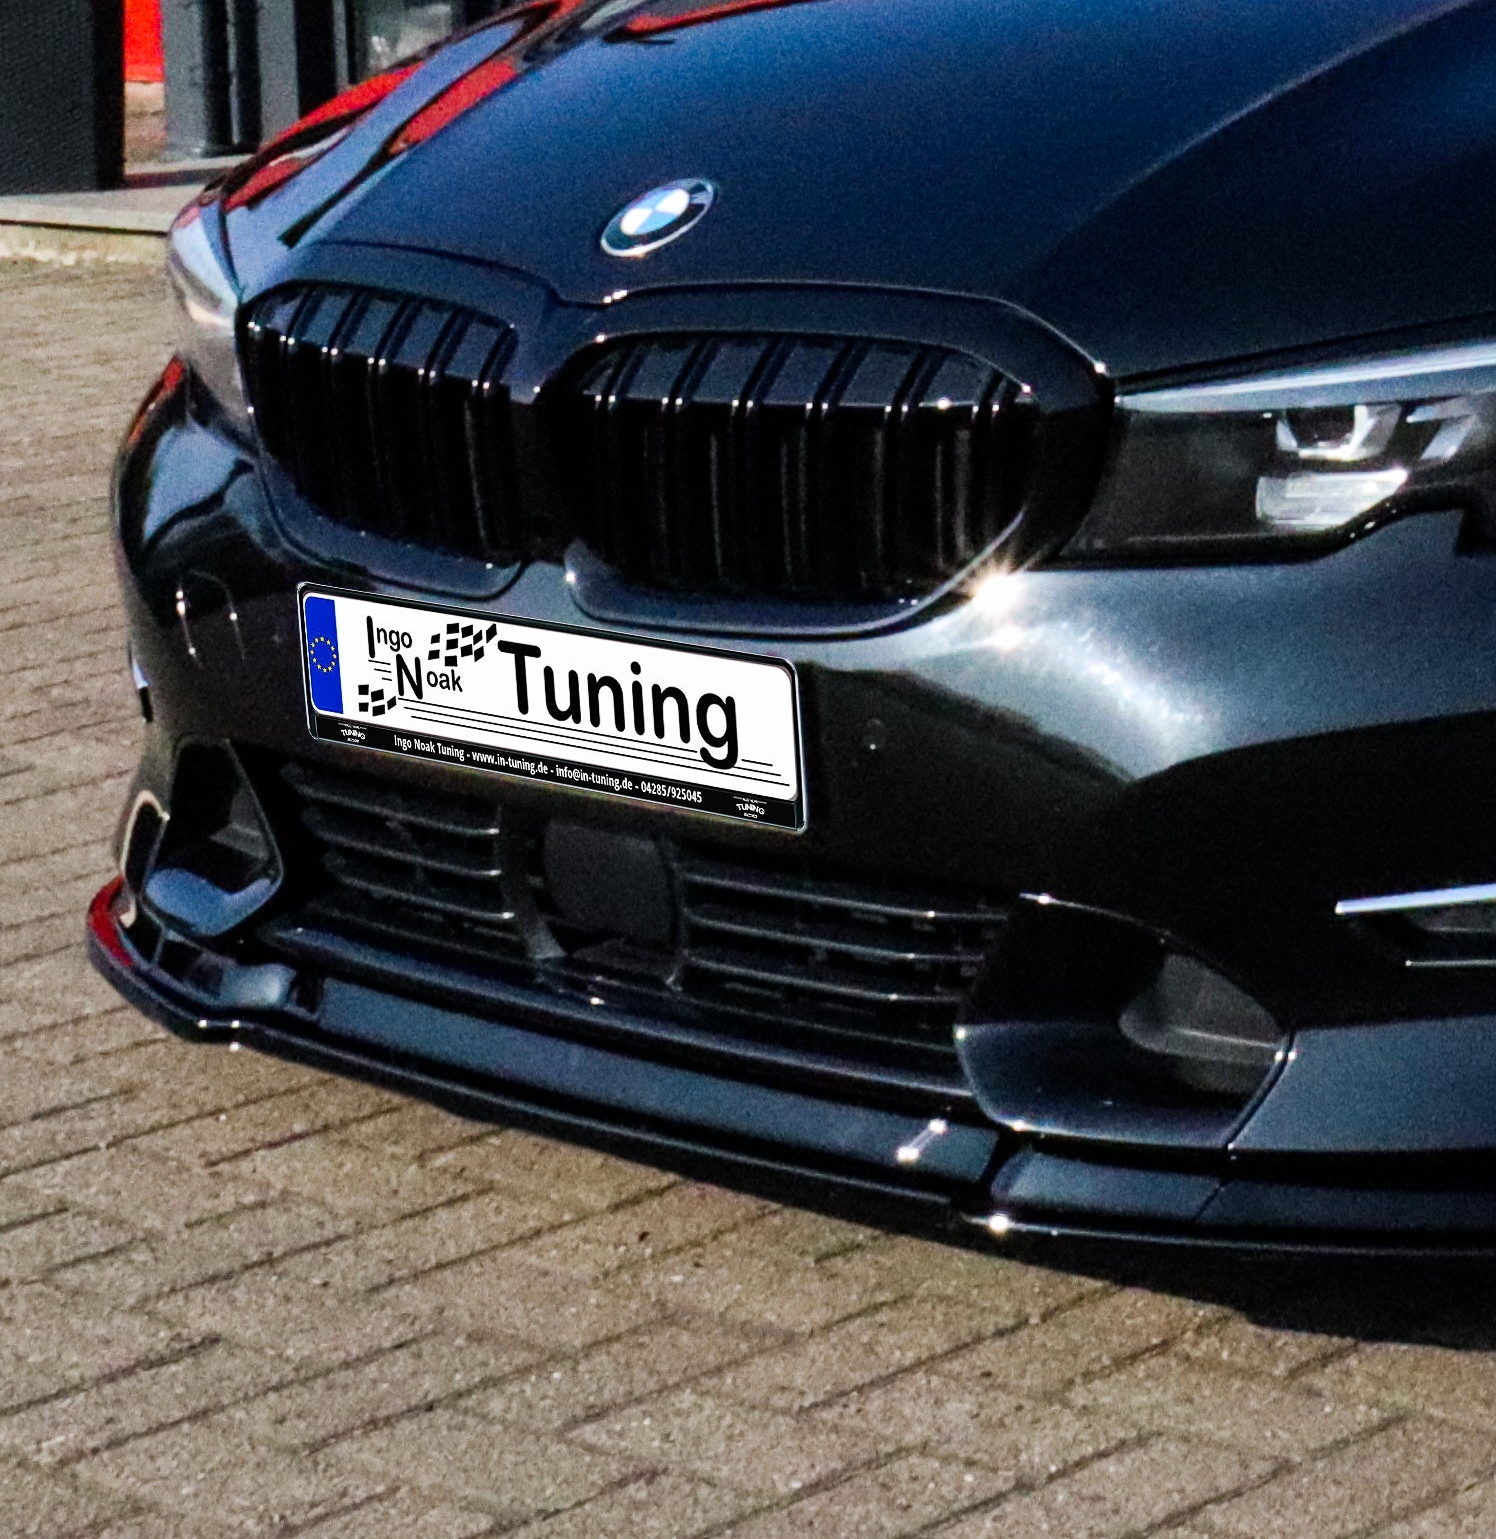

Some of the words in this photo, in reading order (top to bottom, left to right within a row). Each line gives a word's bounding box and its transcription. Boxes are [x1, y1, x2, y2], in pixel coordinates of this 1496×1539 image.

[366, 615, 413, 658] Ingo
[395, 653, 463, 699] Noak
[497, 640, 738, 770] Tuning
[393, 734, 412, 751] Ingo
[414, 738, 436, 754] Noak
[436, 742, 465, 762] Tuning
[471, 751, 549, 776] www.in-tuning.de
[555, 764, 633, 792] info@in-tuning.de
[641, 780, 703, 803] 04285/925045
